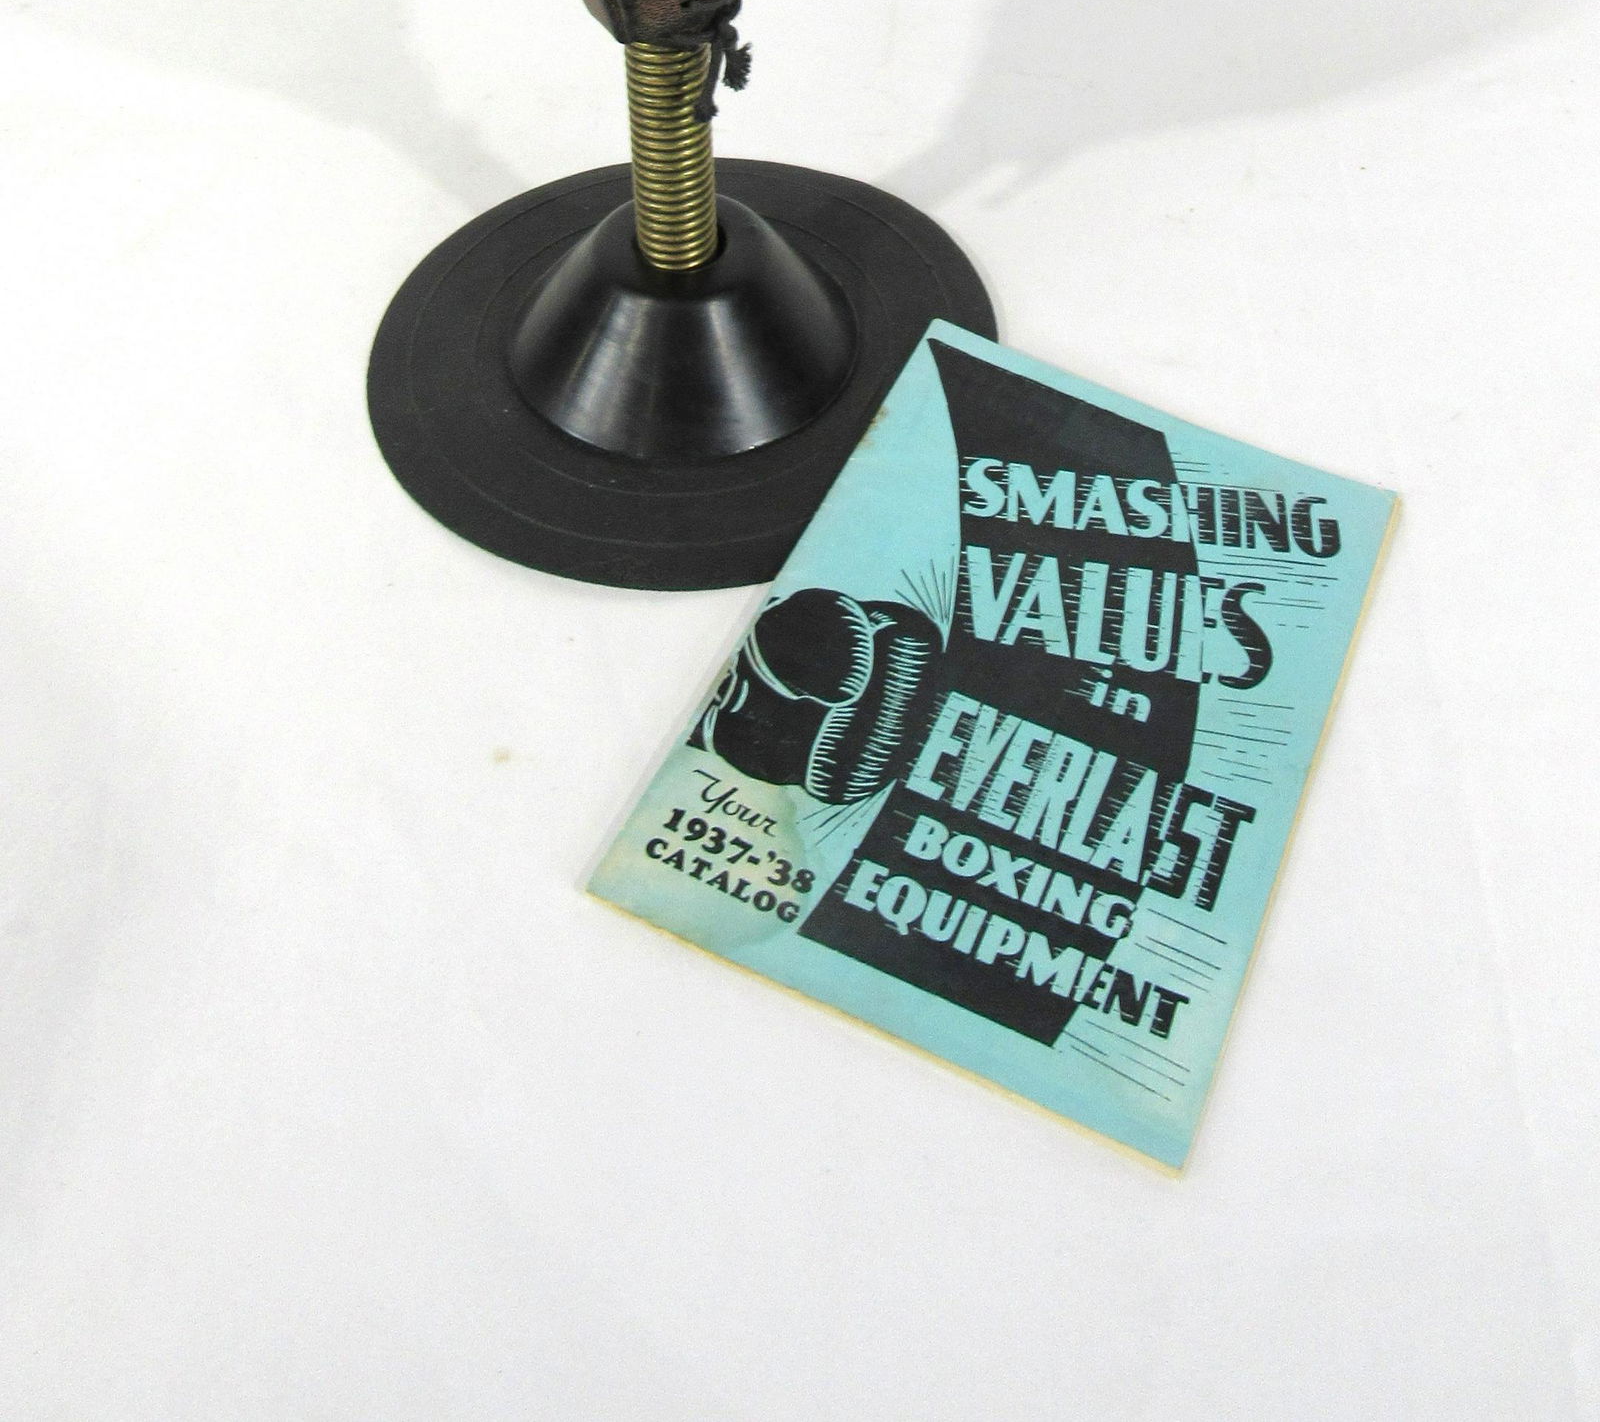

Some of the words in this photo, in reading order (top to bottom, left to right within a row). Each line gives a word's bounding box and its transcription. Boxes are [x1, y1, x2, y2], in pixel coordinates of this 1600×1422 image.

[963, 457, 1342, 559] SMASHING
[964, 544, 1274, 690] VALUES
[1087, 668, 1152, 724] in
[663, 808, 816, 894] 1937-'38
[693, 769, 777, 838] Your
[905, 690, 1257, 912] EVERLAST
[646, 838, 800, 923] CATALOG
[903, 814, 1138, 939] BOXING
[842, 858, 1190, 1039] EQUIPMENT
